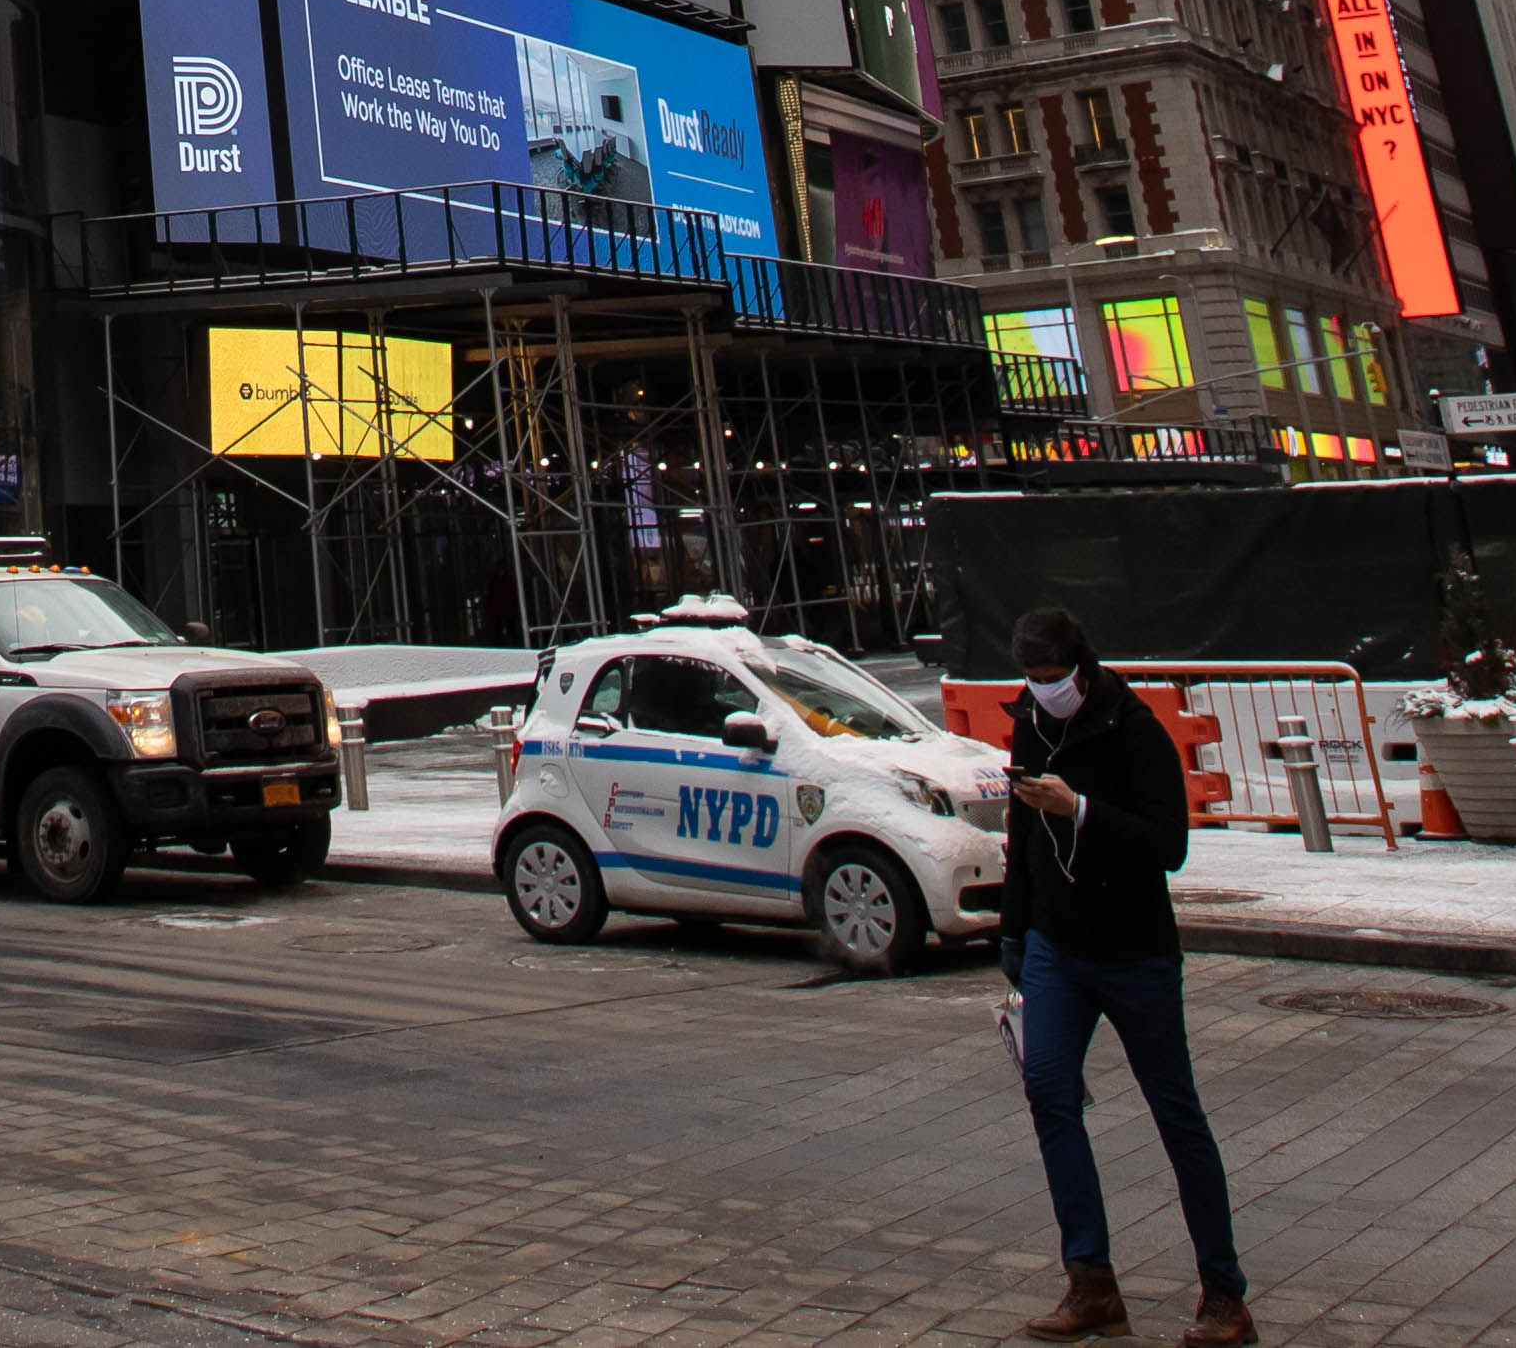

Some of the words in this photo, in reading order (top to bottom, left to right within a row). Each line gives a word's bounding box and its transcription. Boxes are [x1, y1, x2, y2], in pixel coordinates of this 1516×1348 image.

[1354, 31, 1377, 53] IN
[338, 55, 384, 88] Office
[388, 67, 430, 100] Lease
[433, 79, 475, 111] Terms
[478, 91, 506, 119] that
[1360, 71, 1389, 92] ON
[341, 91, 384, 125] Work
[387, 103, 412, 131] the
[416, 109, 447, 143] Way
[450, 117, 477, 145] You
[480, 125, 500, 151] Do
[1361, 104, 1405, 127] NYC
[658, 98, 746, 171] DurstReady
[179, 142, 242, 174] Durst
[1384, 140, 1396, 160] ?
[256, 383, 311, 400] bumbe
[1457, 399, 1511, 413] PEDESTRIAN
[1318, 740, 1363, 750] ROCK
[677, 785, 780, 849] NYPD
